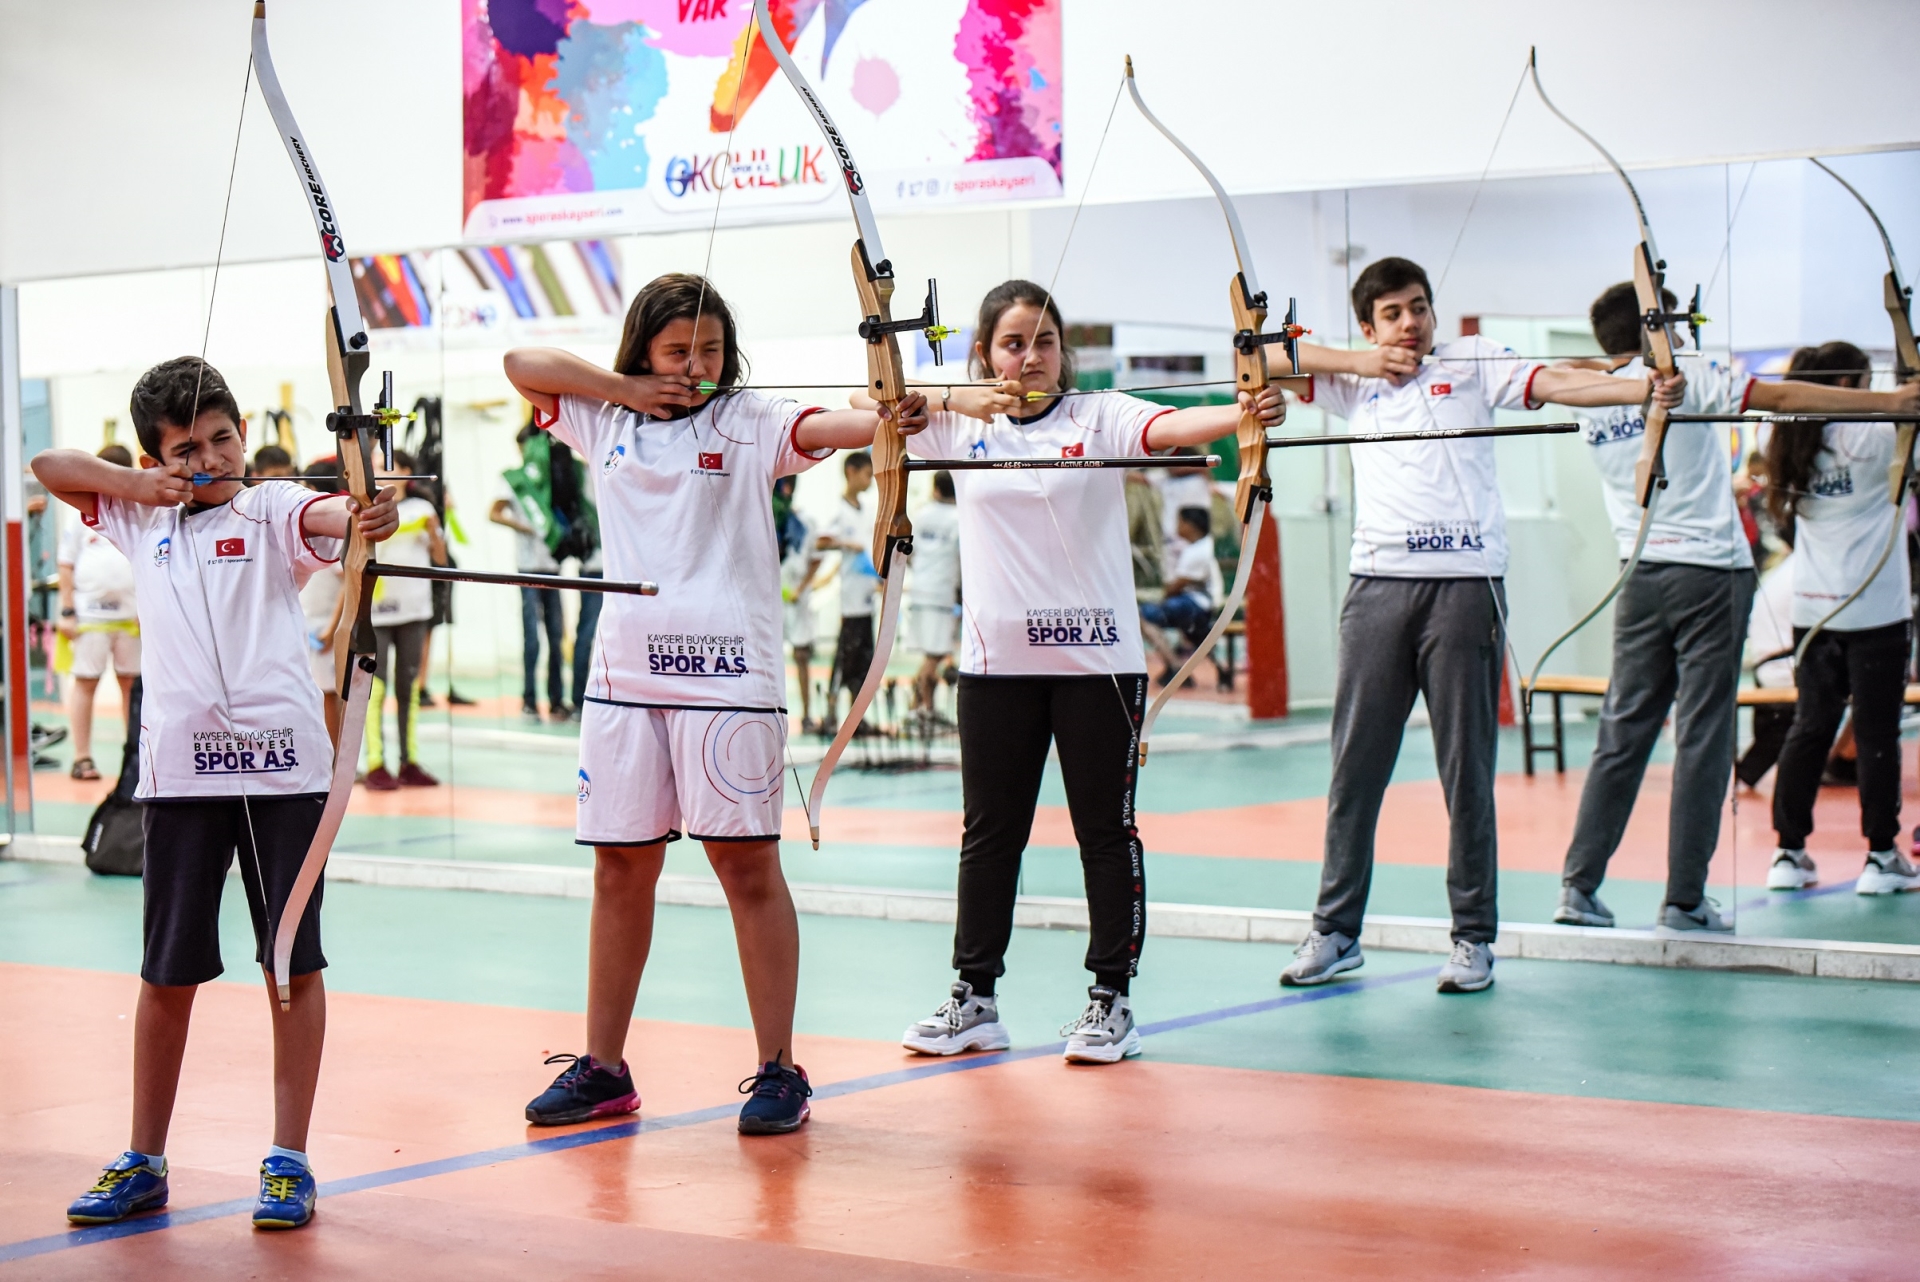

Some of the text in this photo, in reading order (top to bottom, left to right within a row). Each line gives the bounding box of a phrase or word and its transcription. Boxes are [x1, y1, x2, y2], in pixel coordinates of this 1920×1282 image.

[800, 85, 854, 171] CORE ARCHERY
[289, 135, 336, 235] CORE ARCHERY
[1406, 535, 1454, 550] SPOR
[1026, 607, 1062, 618] KAYSERİ
[1027, 616, 1116, 626] BELEDİYESİ
[647, 633, 744, 646] KAYSERİ BÜYÜKŞEHİR
[1028, 626, 1083, 643] SPOR
[648, 644, 744, 656] BELEDİYESİ
[648, 653, 750, 678] SPOR A.Ş.
[234, 727, 294, 742] BÜYÜKŞEHİR
[194, 737, 294, 752] BELEDİYESİ
[194, 748, 300, 772] SPOR A.Ş.
[1122, 789, 1132, 827] VOGUE
[1130, 840, 1140, 878] VOGUE
[1132, 900, 1141, 937] VOGUE
